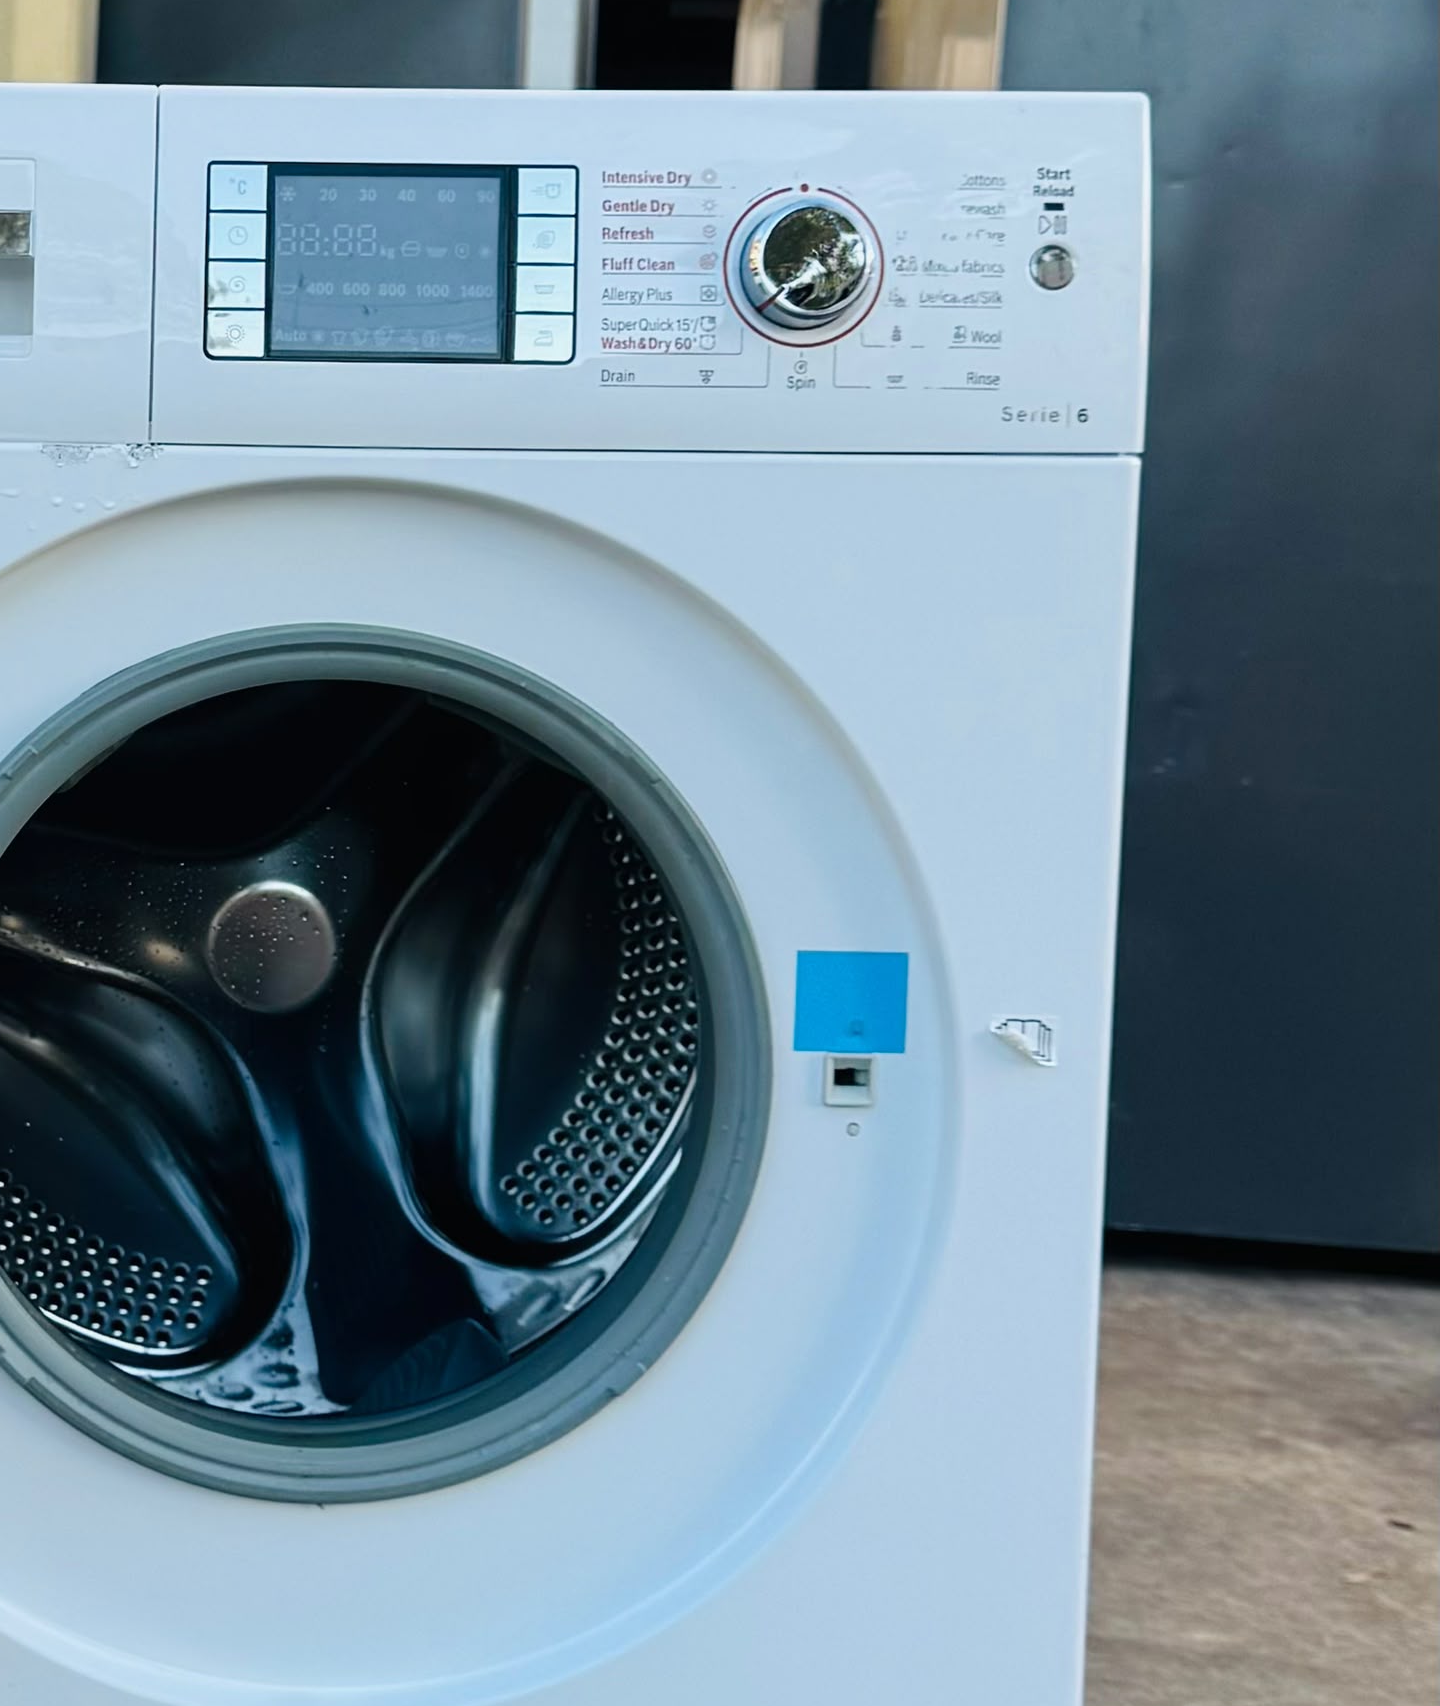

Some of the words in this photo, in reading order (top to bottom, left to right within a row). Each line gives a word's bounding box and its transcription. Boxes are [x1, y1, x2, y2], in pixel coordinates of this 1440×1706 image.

[602, 170, 664, 184] Intensive
[666, 172, 692, 187] Dry
[1036, 167, 1070, 181] Start
[320, 188, 337, 202] 20
[360, 189, 377, 202] 30
[397, 189, 416, 202] 40
[438, 189, 456, 202] 60
[602, 199, 647, 213] Gentle
[650, 200, 675, 215] Dry
[602, 227, 654, 240] Refresh
[602, 258, 633, 271] Fluff
[637, 258, 675, 271] Clean
[307, 282, 334, 295] 400
[343, 283, 370, 296] 600
[378, 283, 405, 296] 800
[417, 284, 449, 297] 1000
[601, 288, 643, 304] Allergy
[647, 288, 673, 301] Plus
[971, 330, 1002, 343] Wool
[601, 369, 635, 383] Drain
[967, 372, 1000, 385] Rinse
[787, 376, 816, 391] Spin
[1001, 407, 1060, 423] Serie
[1077, 409, 1089, 423] 6
